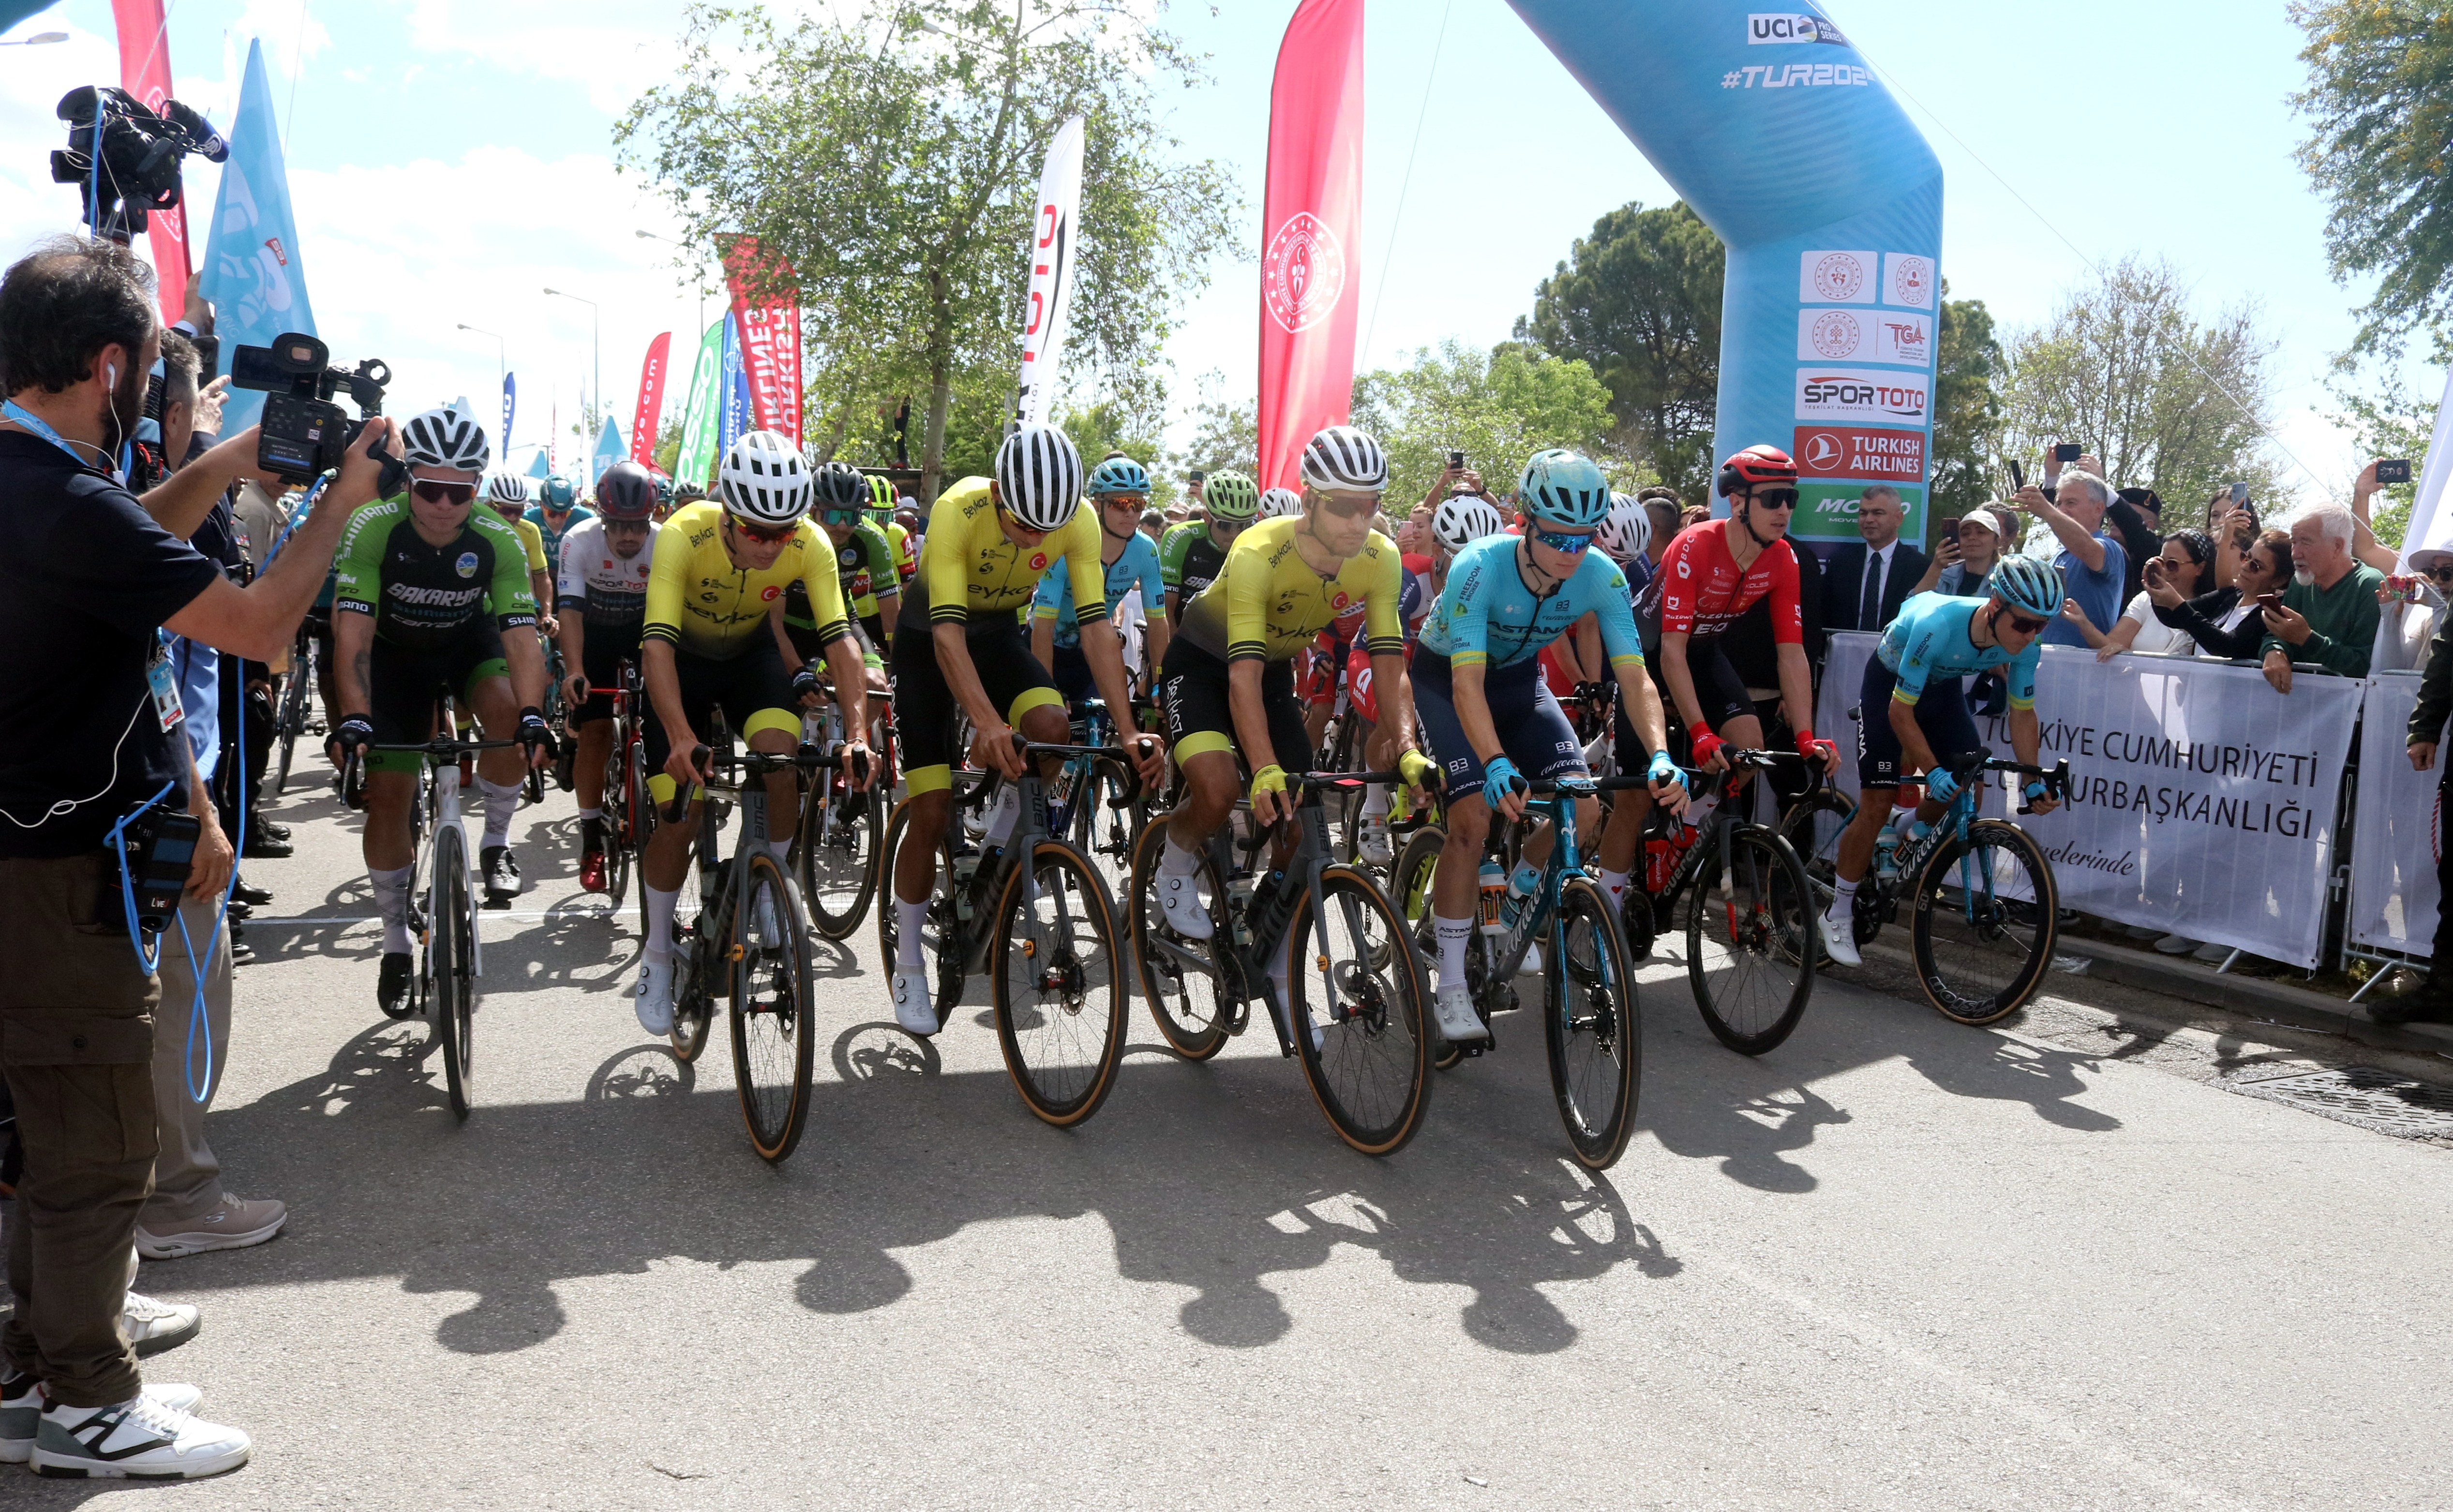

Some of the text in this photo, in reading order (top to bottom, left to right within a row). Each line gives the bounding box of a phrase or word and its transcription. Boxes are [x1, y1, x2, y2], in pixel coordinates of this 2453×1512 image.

[1753, 19, 1794, 38] UCI
[1818, 21, 1831, 31] PRO
[1821, 30, 1842, 42] SERIES
[1885, 320, 1925, 349] TGA
[1852, 436, 1920, 455] TURKISH
[1850, 455, 1919, 474] AIRLINES
[963, 496, 989, 519] Beykoz
[343, 502, 399, 559] SHIMANO
[690, 527, 715, 548] Beykoz
[1164, 526, 1199, 557] SHIMANO
[1268, 540, 1292, 568] Beykoz
[1680, 535, 1695, 561] BDC
[1637, 560, 1650, 581] ADRIA
[1400, 582, 1416, 604] ADRIA
[1460, 565, 1482, 600] FREEDOM
[1466, 581, 1481, 602] BROKER
[388, 583, 482, 607] SAKARYA
[1556, 600, 1570, 609] B3
[1914, 632, 1933, 656] FREEDOM
[1166, 675, 1184, 741] Beykoz
[1555, 741, 1574, 751] B3
[1987, 712, 2318, 787] TÜKİYE CUMHURİYETİ
[1449, 757, 1468, 773] B3
[1878, 761, 1892, 770] B3
[1032, 783, 1044, 827] BMC
[754, 796, 765, 840] BMC
[1315, 811, 1330, 853] BMC
